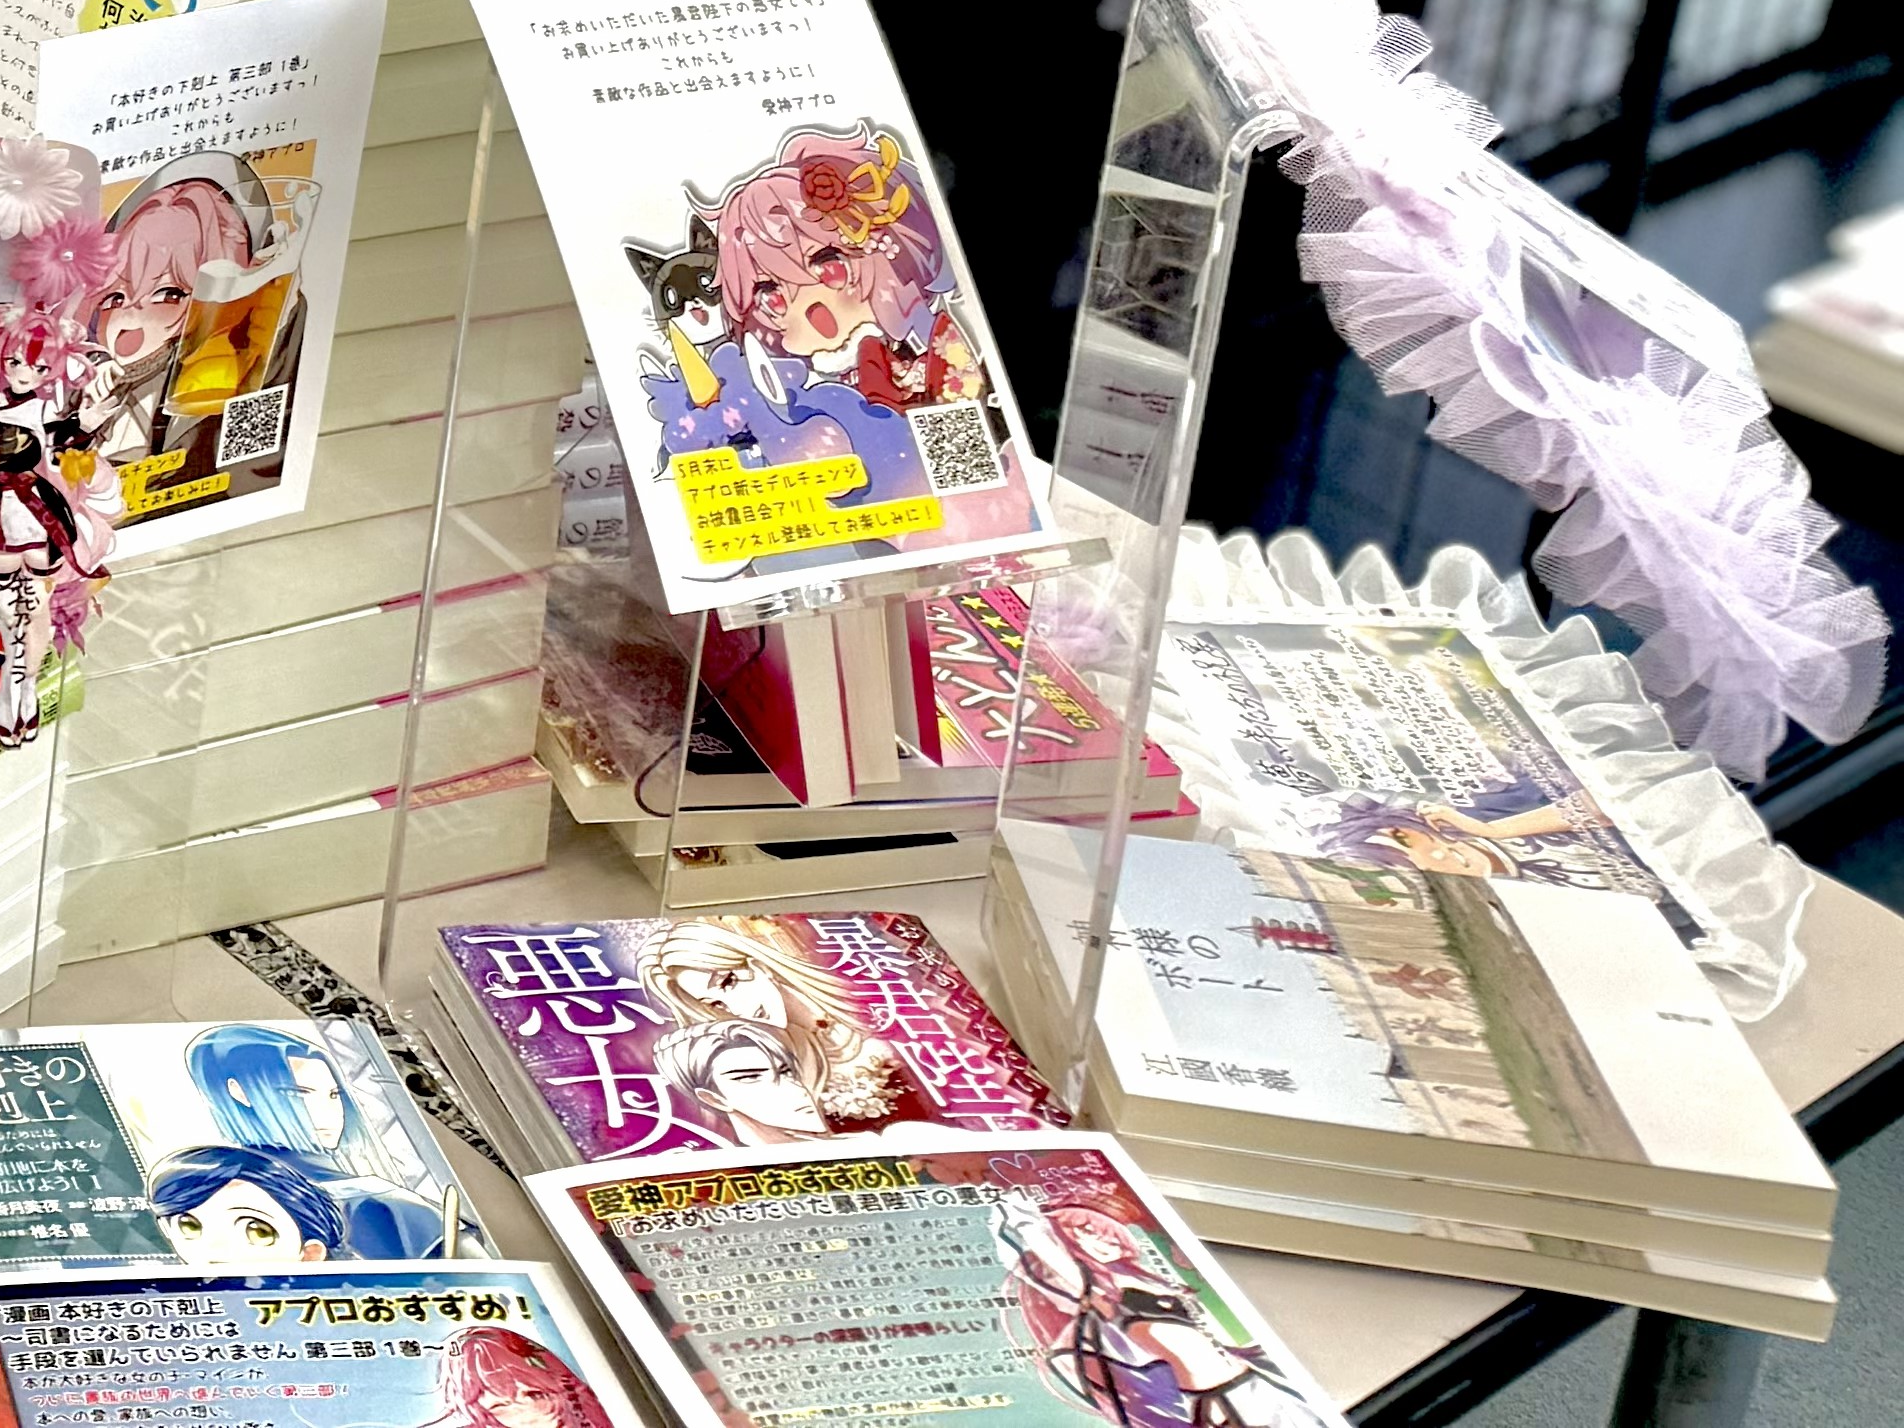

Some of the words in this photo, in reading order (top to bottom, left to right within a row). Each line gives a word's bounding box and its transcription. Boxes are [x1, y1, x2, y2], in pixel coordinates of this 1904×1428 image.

[660, 50, 735, 72] これからも
[760, 92, 837, 116] 愛神アプロ
[170, 110, 235, 137] これからも
[685, 462, 861, 503] アプロ新モデルチェンジ
[1144, 1052, 1300, 1092] 江國香織
[588, 1161, 915, 1219] 愛神アプロおすすめ!
[57, 1297, 226, 1323] 本好きの下剋上
[246, 1293, 535, 1327] アプロおすすめ!
[6, 1343, 298, 1373] 手段を選んでいられません
[304, 1340, 379, 1362] 第三部
